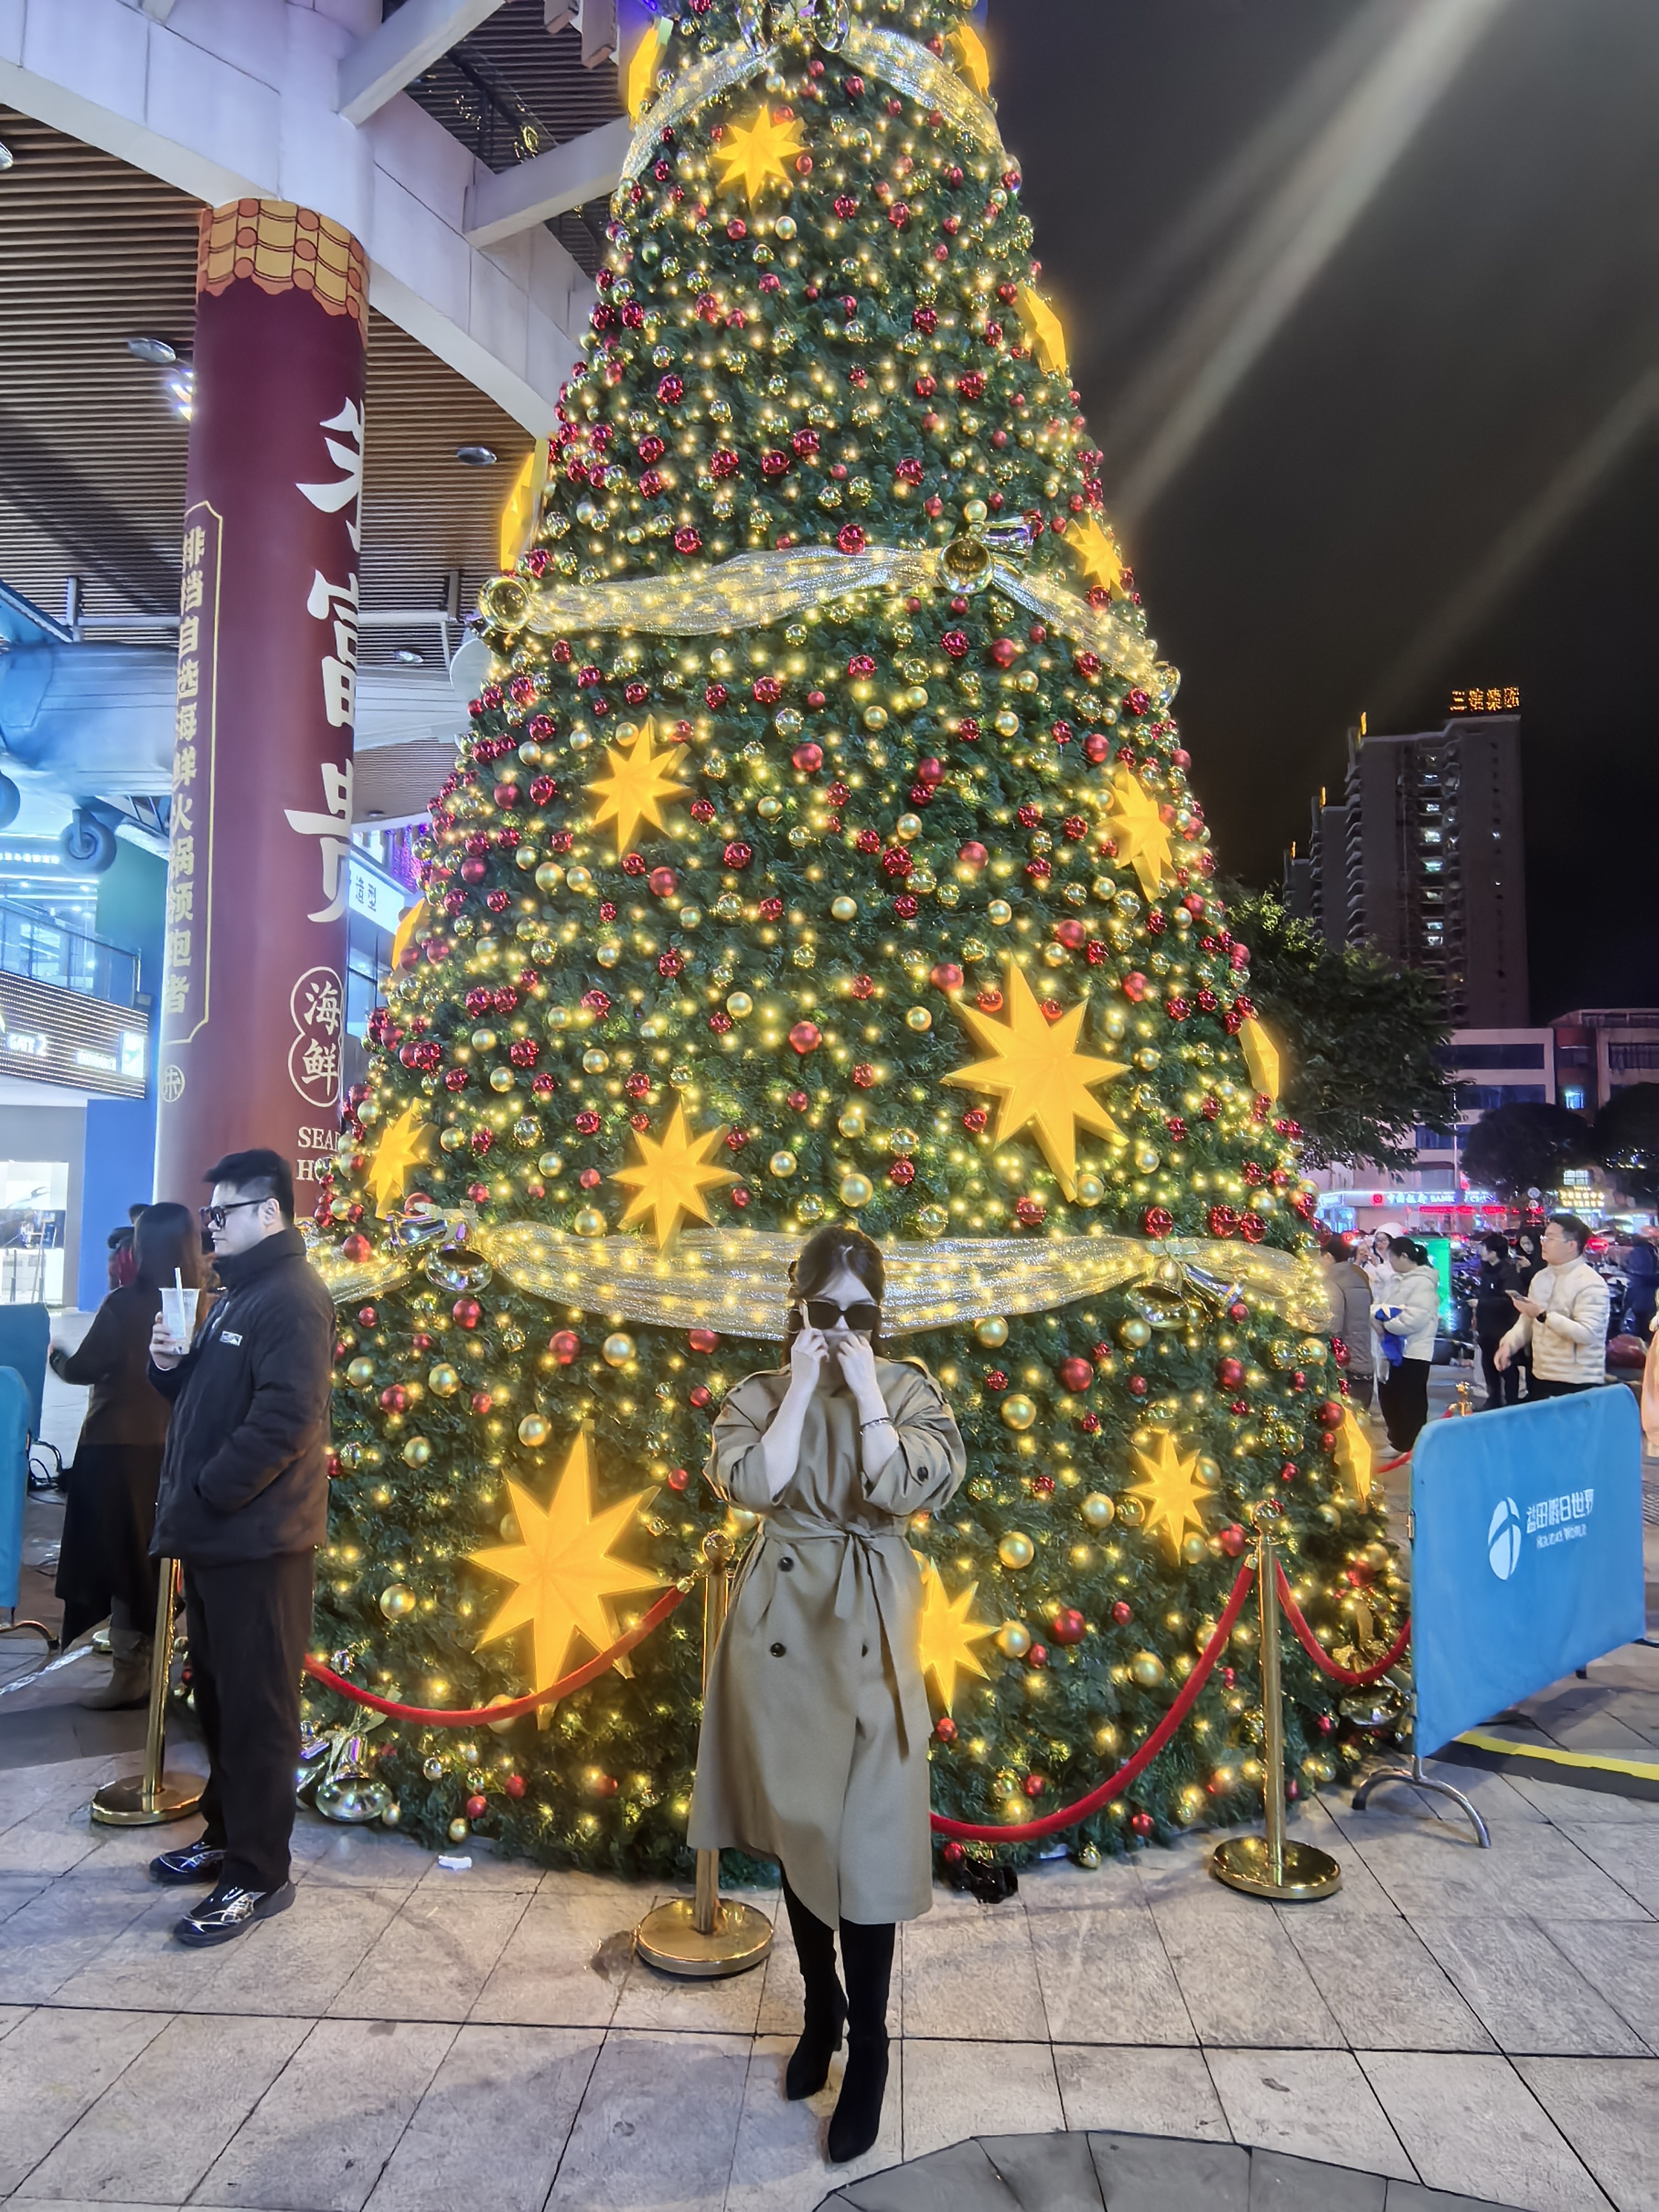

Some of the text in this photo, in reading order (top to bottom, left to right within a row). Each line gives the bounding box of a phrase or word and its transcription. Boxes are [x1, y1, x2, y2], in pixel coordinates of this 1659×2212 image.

[348, 869, 376, 912] 造型
[36, 1034, 47, 1057] 2
[301, 981, 341, 1096] 海鲜
